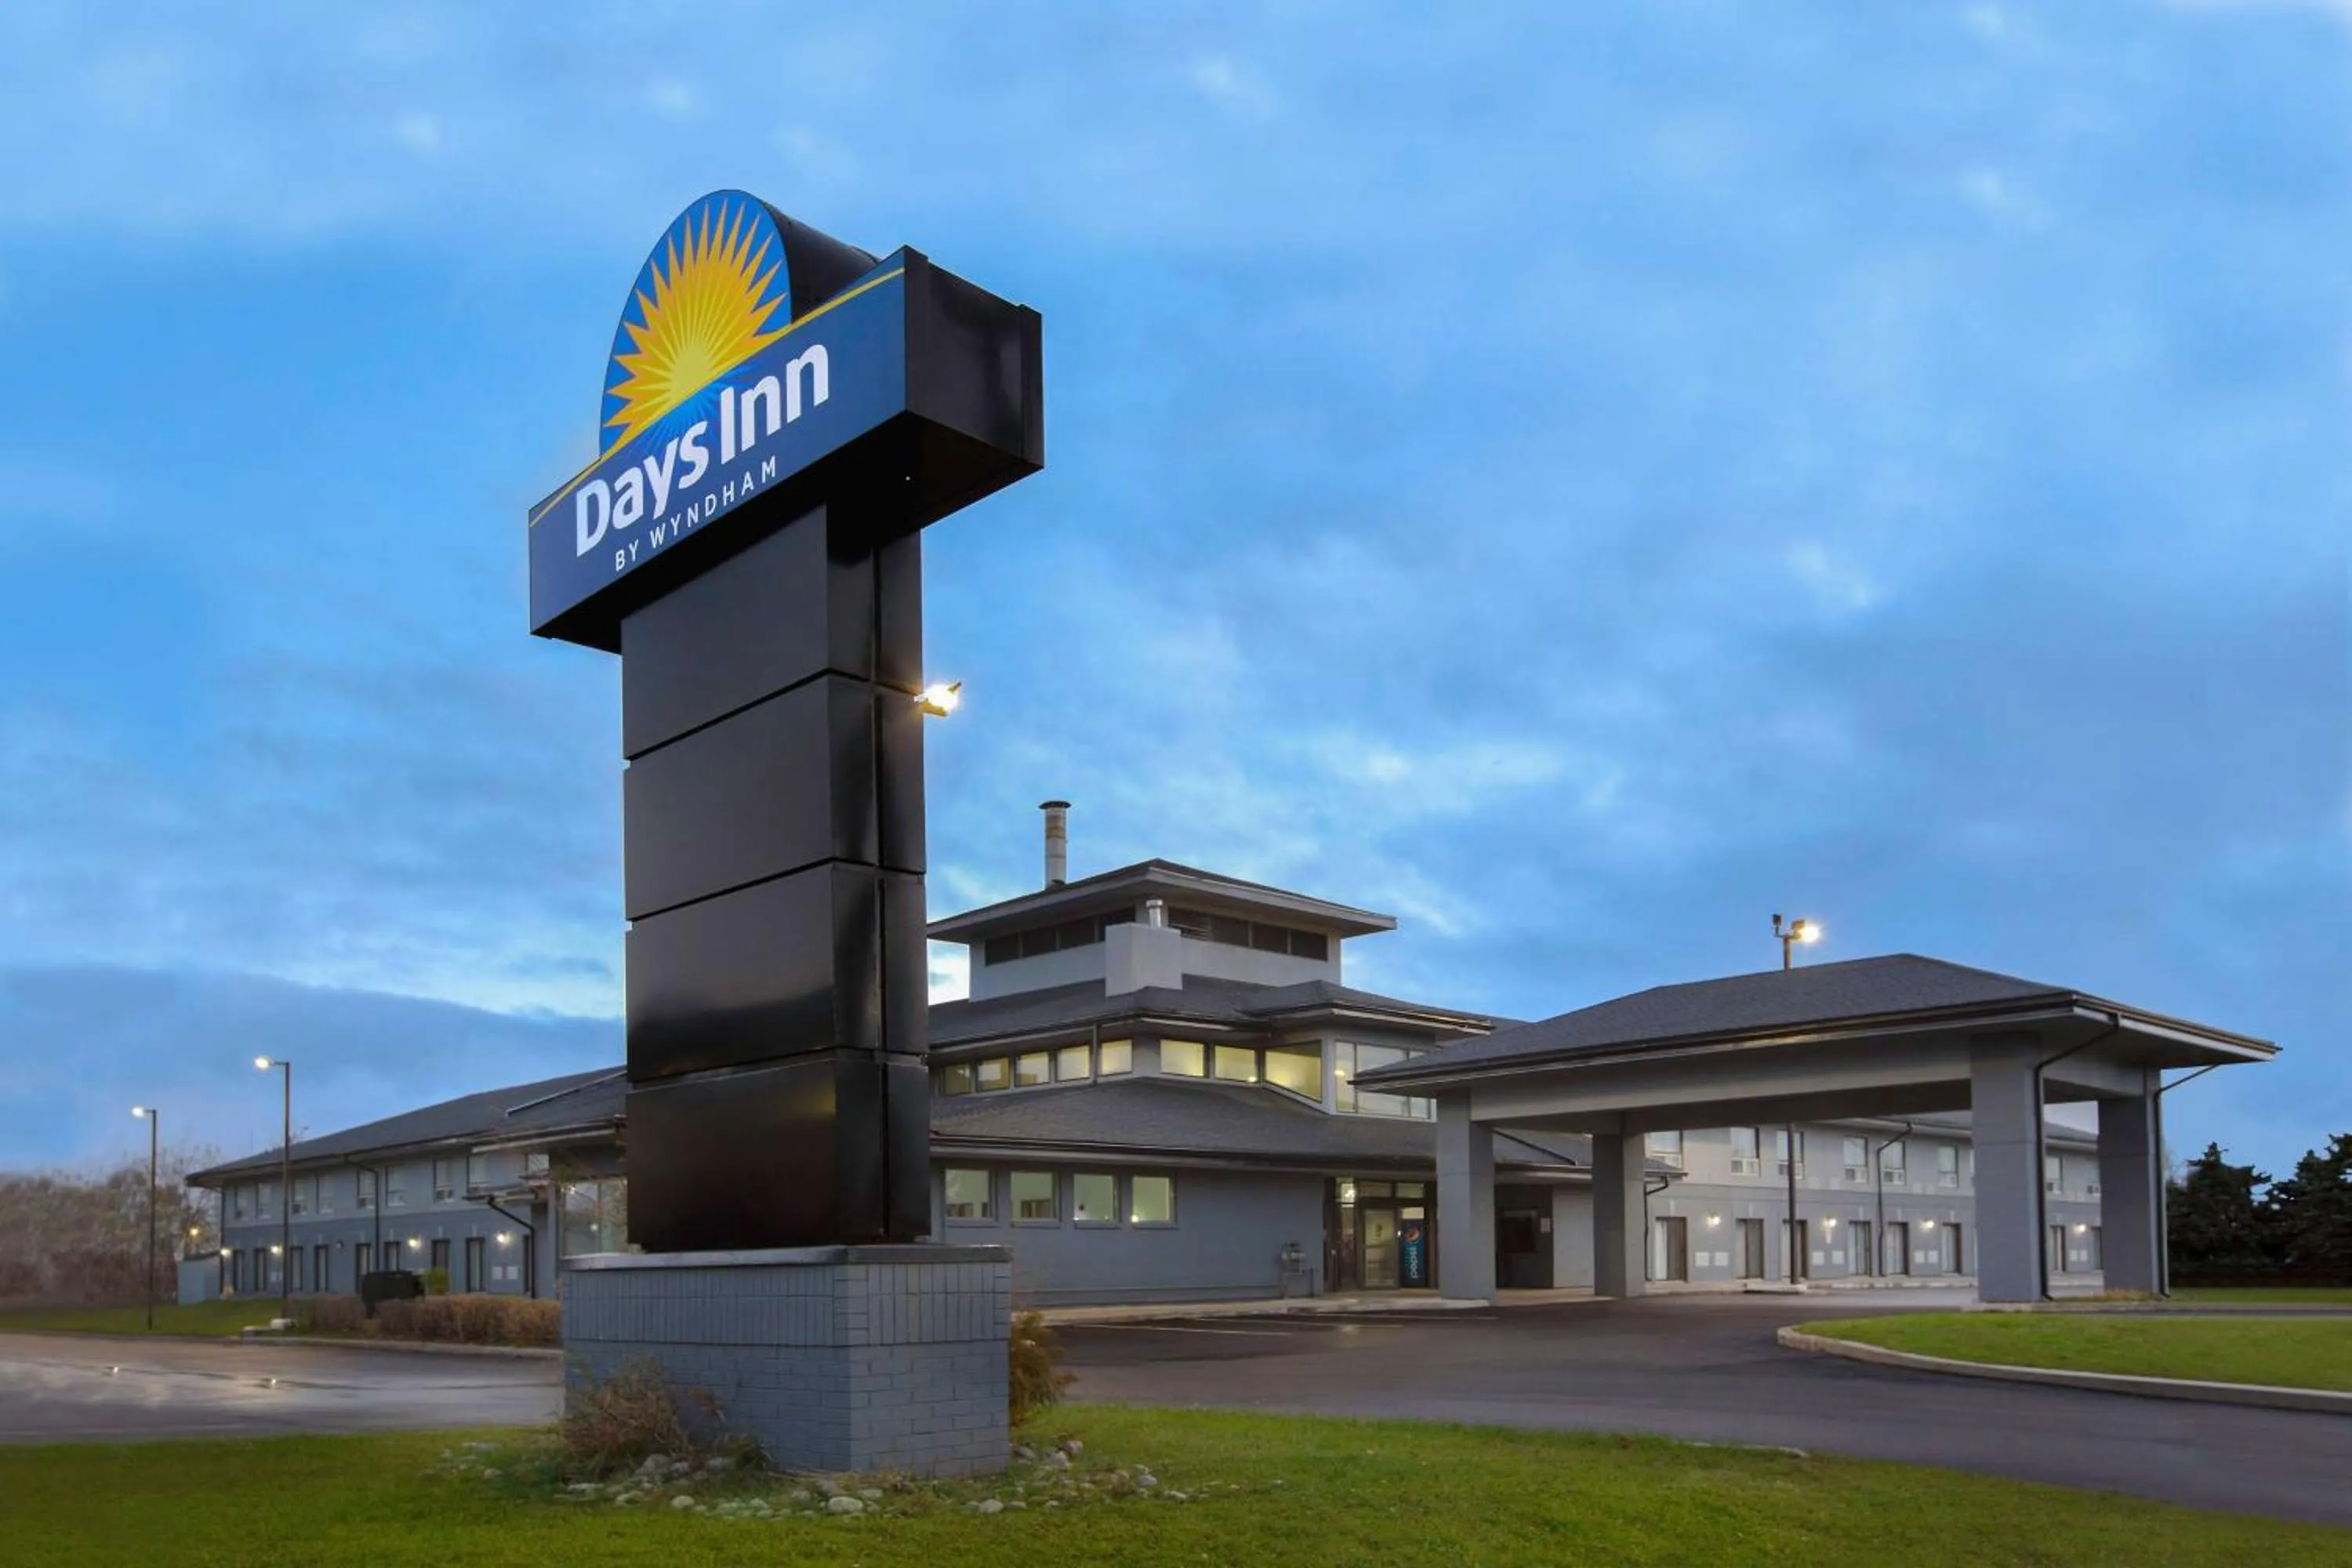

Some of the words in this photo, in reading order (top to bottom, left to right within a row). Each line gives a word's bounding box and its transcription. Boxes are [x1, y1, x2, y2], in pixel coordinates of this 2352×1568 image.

[575, 421, 710, 557] Days
[720, 343, 829, 465] Inn
[615, 539, 640, 572] BY
[649, 456, 775, 549] WYNDHAM
